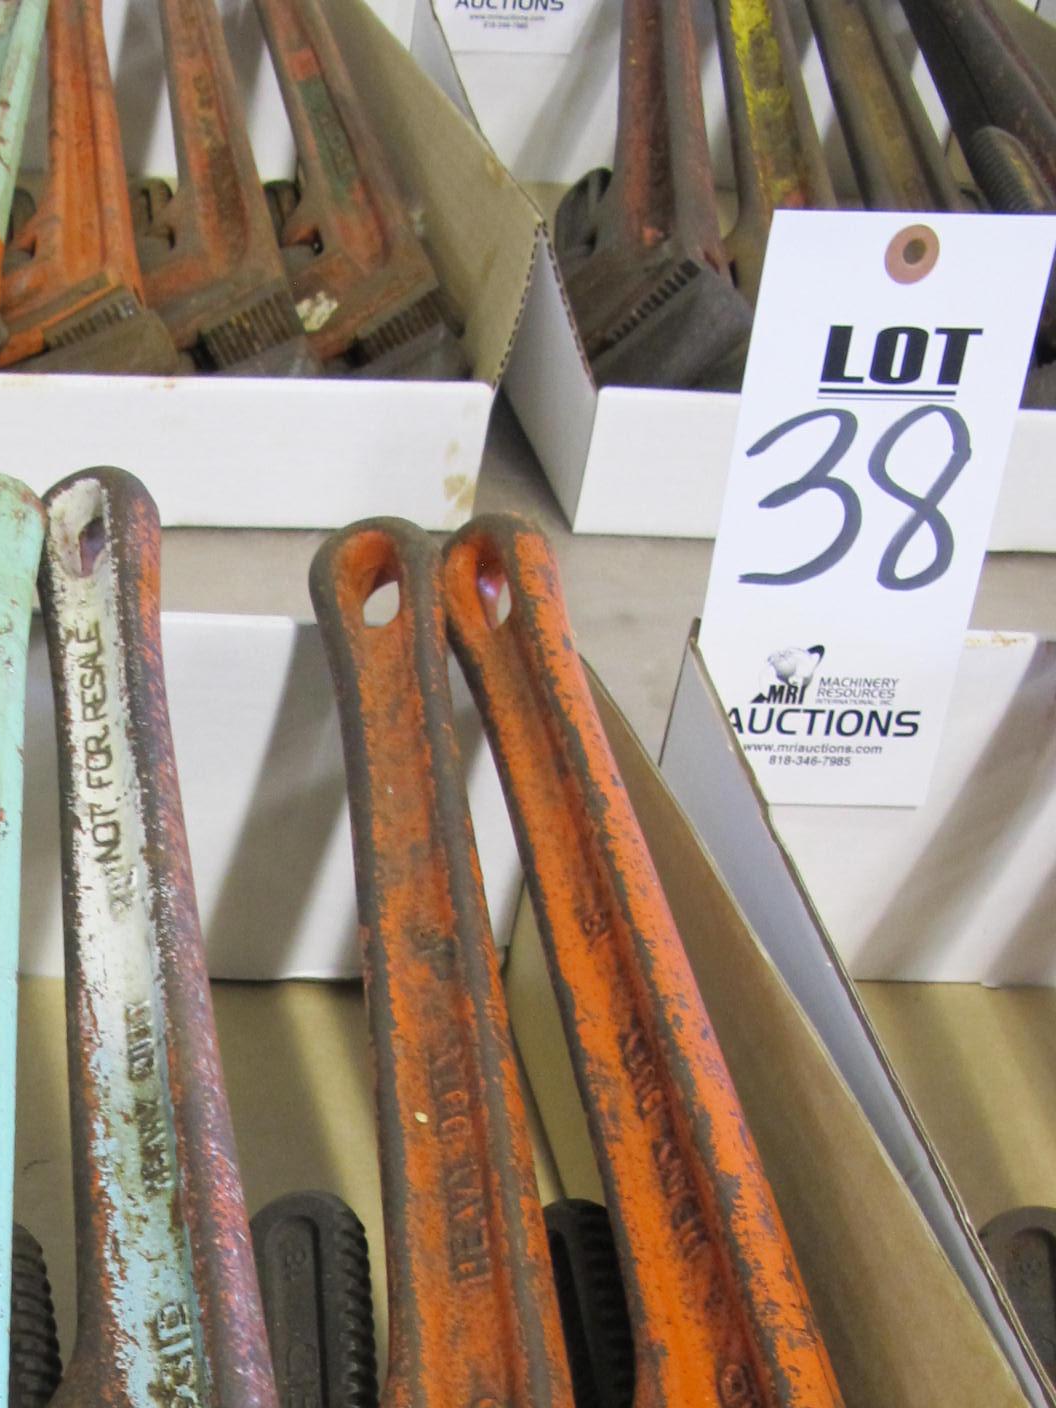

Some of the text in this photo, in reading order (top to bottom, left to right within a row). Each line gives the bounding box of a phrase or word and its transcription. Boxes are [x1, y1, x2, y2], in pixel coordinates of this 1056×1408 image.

[820, 325, 984, 385] LOT
[738, 404, 973, 591] 38
[816, 687, 896, 699] RESOURCES
[819, 677, 900, 689] MACHINERY
[767, 684, 807, 705] MRI
[728, 706, 922, 737] AUCTIONS
[76, 621, 121, 864] NOT FOR RESALE
[744, 742, 883, 754] www.mriauctions.com
[769, 755, 852, 767] 818-346-7985
